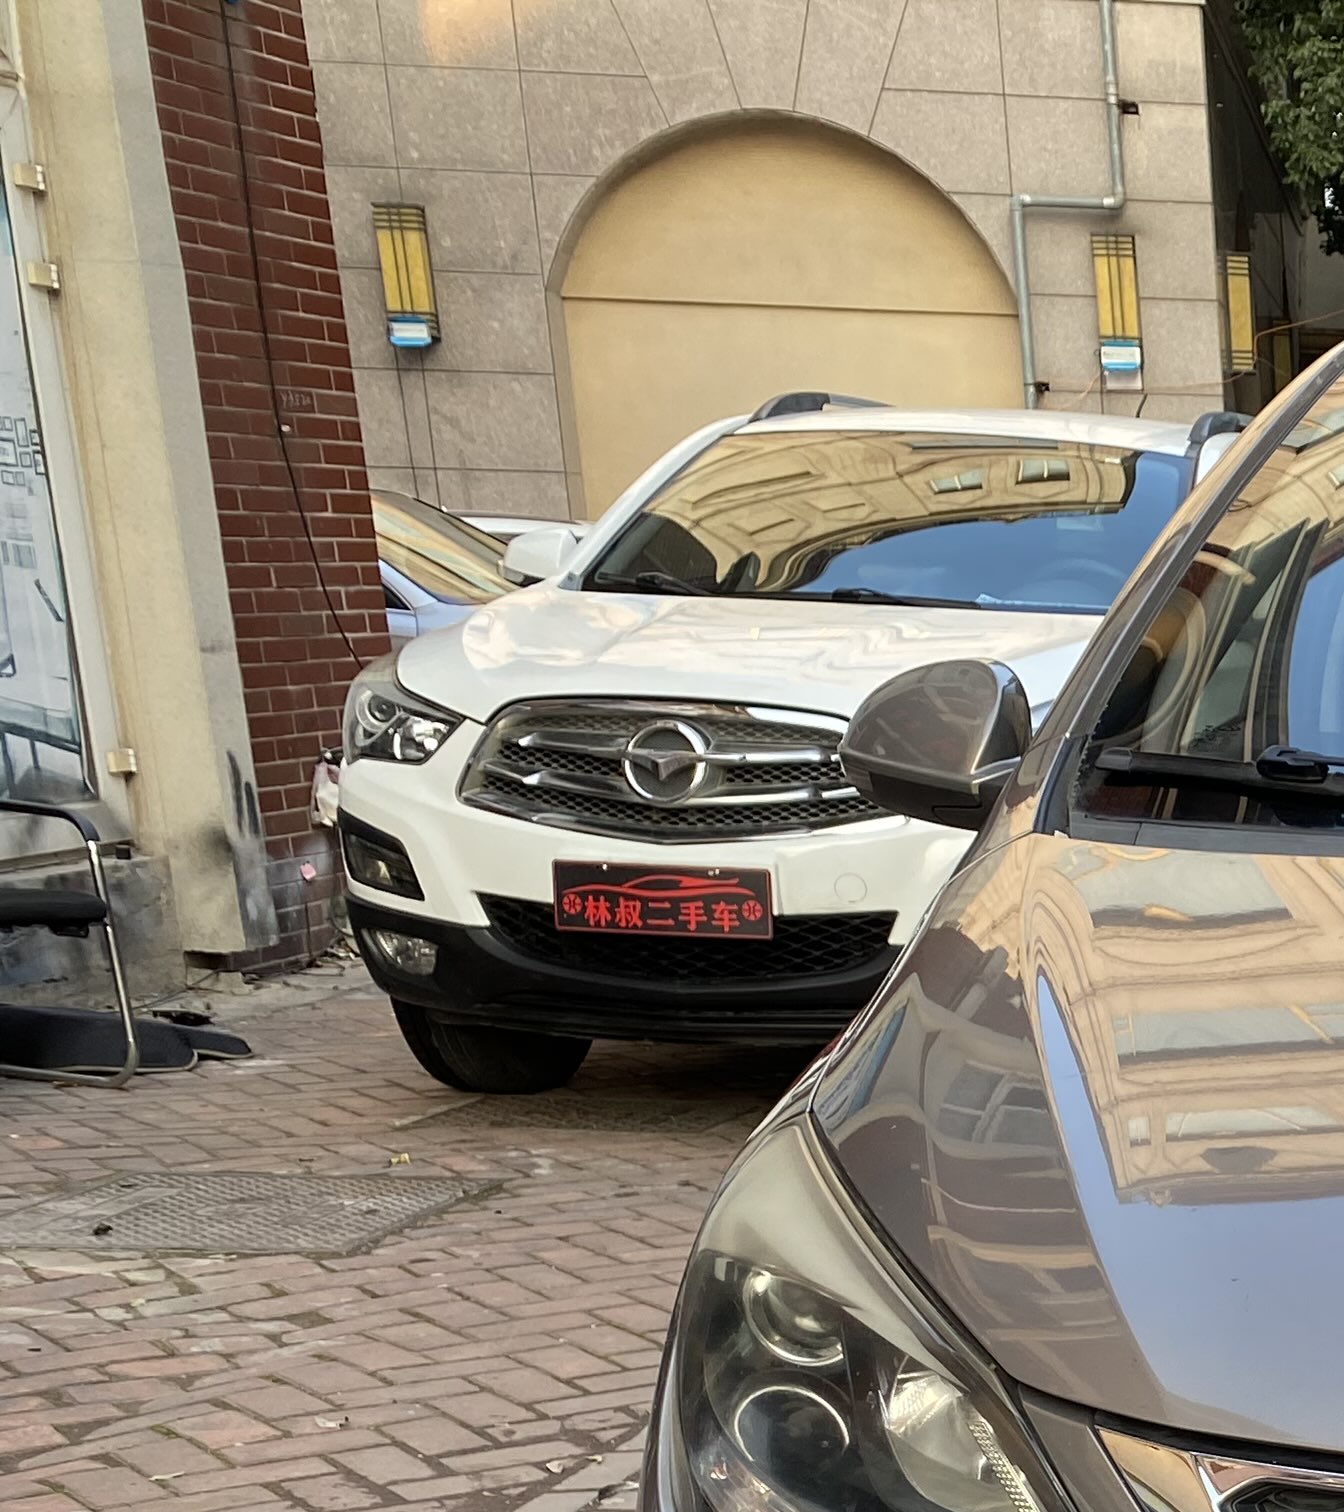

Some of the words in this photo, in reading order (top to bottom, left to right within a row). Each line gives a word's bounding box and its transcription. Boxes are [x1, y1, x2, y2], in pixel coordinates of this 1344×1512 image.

[584, 895, 740, 933] 林叔二手车
